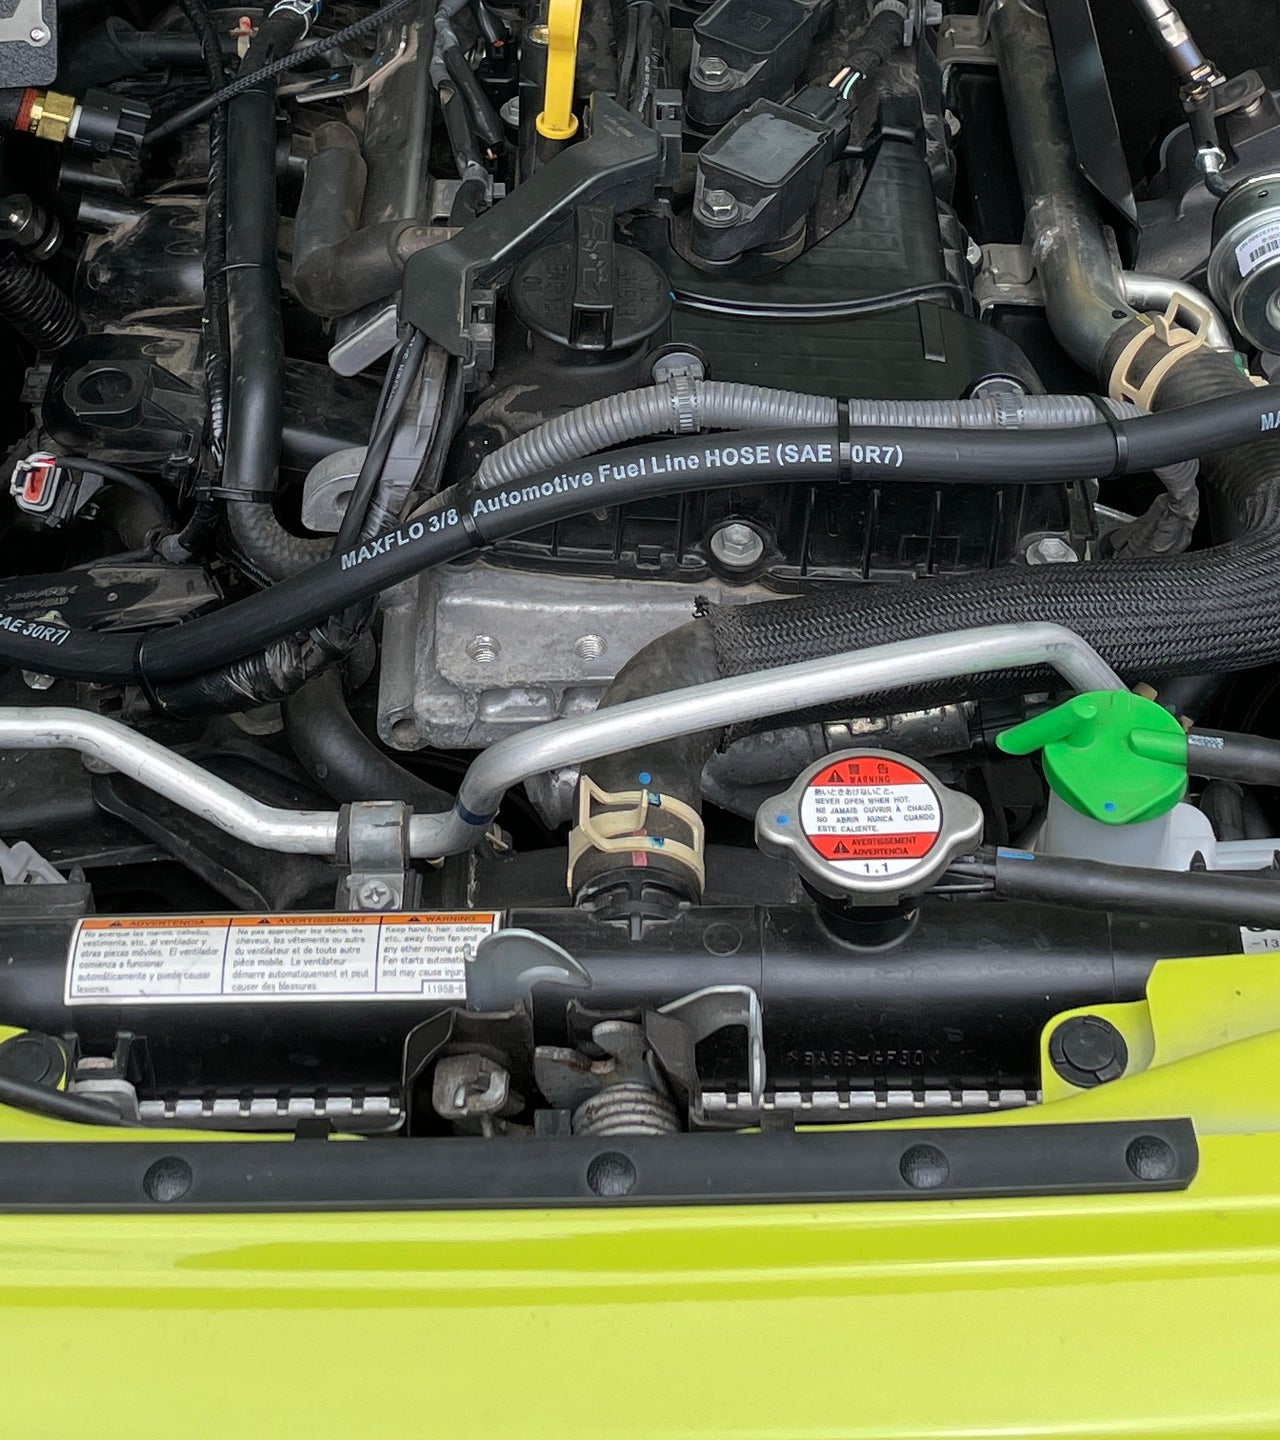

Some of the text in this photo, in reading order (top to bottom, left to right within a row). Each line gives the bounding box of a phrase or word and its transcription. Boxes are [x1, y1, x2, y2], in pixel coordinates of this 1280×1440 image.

[340, 521, 424, 570] MAXFLO
[472, 471, 594, 517] Automotive
[598, 457, 645, 483] Fuel
[651, 454, 699, 474] Line
[705, 444, 771, 469] HOSE
[776, 442, 832, 466] (SAE
[850, 444, 903, 468] 0R7)
[850, 775, 890, 783] WARNING
[830, 806, 858, 814] JAMAIS
[852, 837, 916, 845] AVERTISSEMENT
[852, 848, 908, 856] ADVERTENCIA
[864, 863, 888, 873] 1.1
[400, 945, 421, 953] other
[424, 945, 452, 953] moving
[383, 956, 398, 964] Fan
[400, 956, 426, 964] starts
[383, 968, 396, 976] and
[399, 969, 416, 978] may
[419, 968, 442, 976] cause
